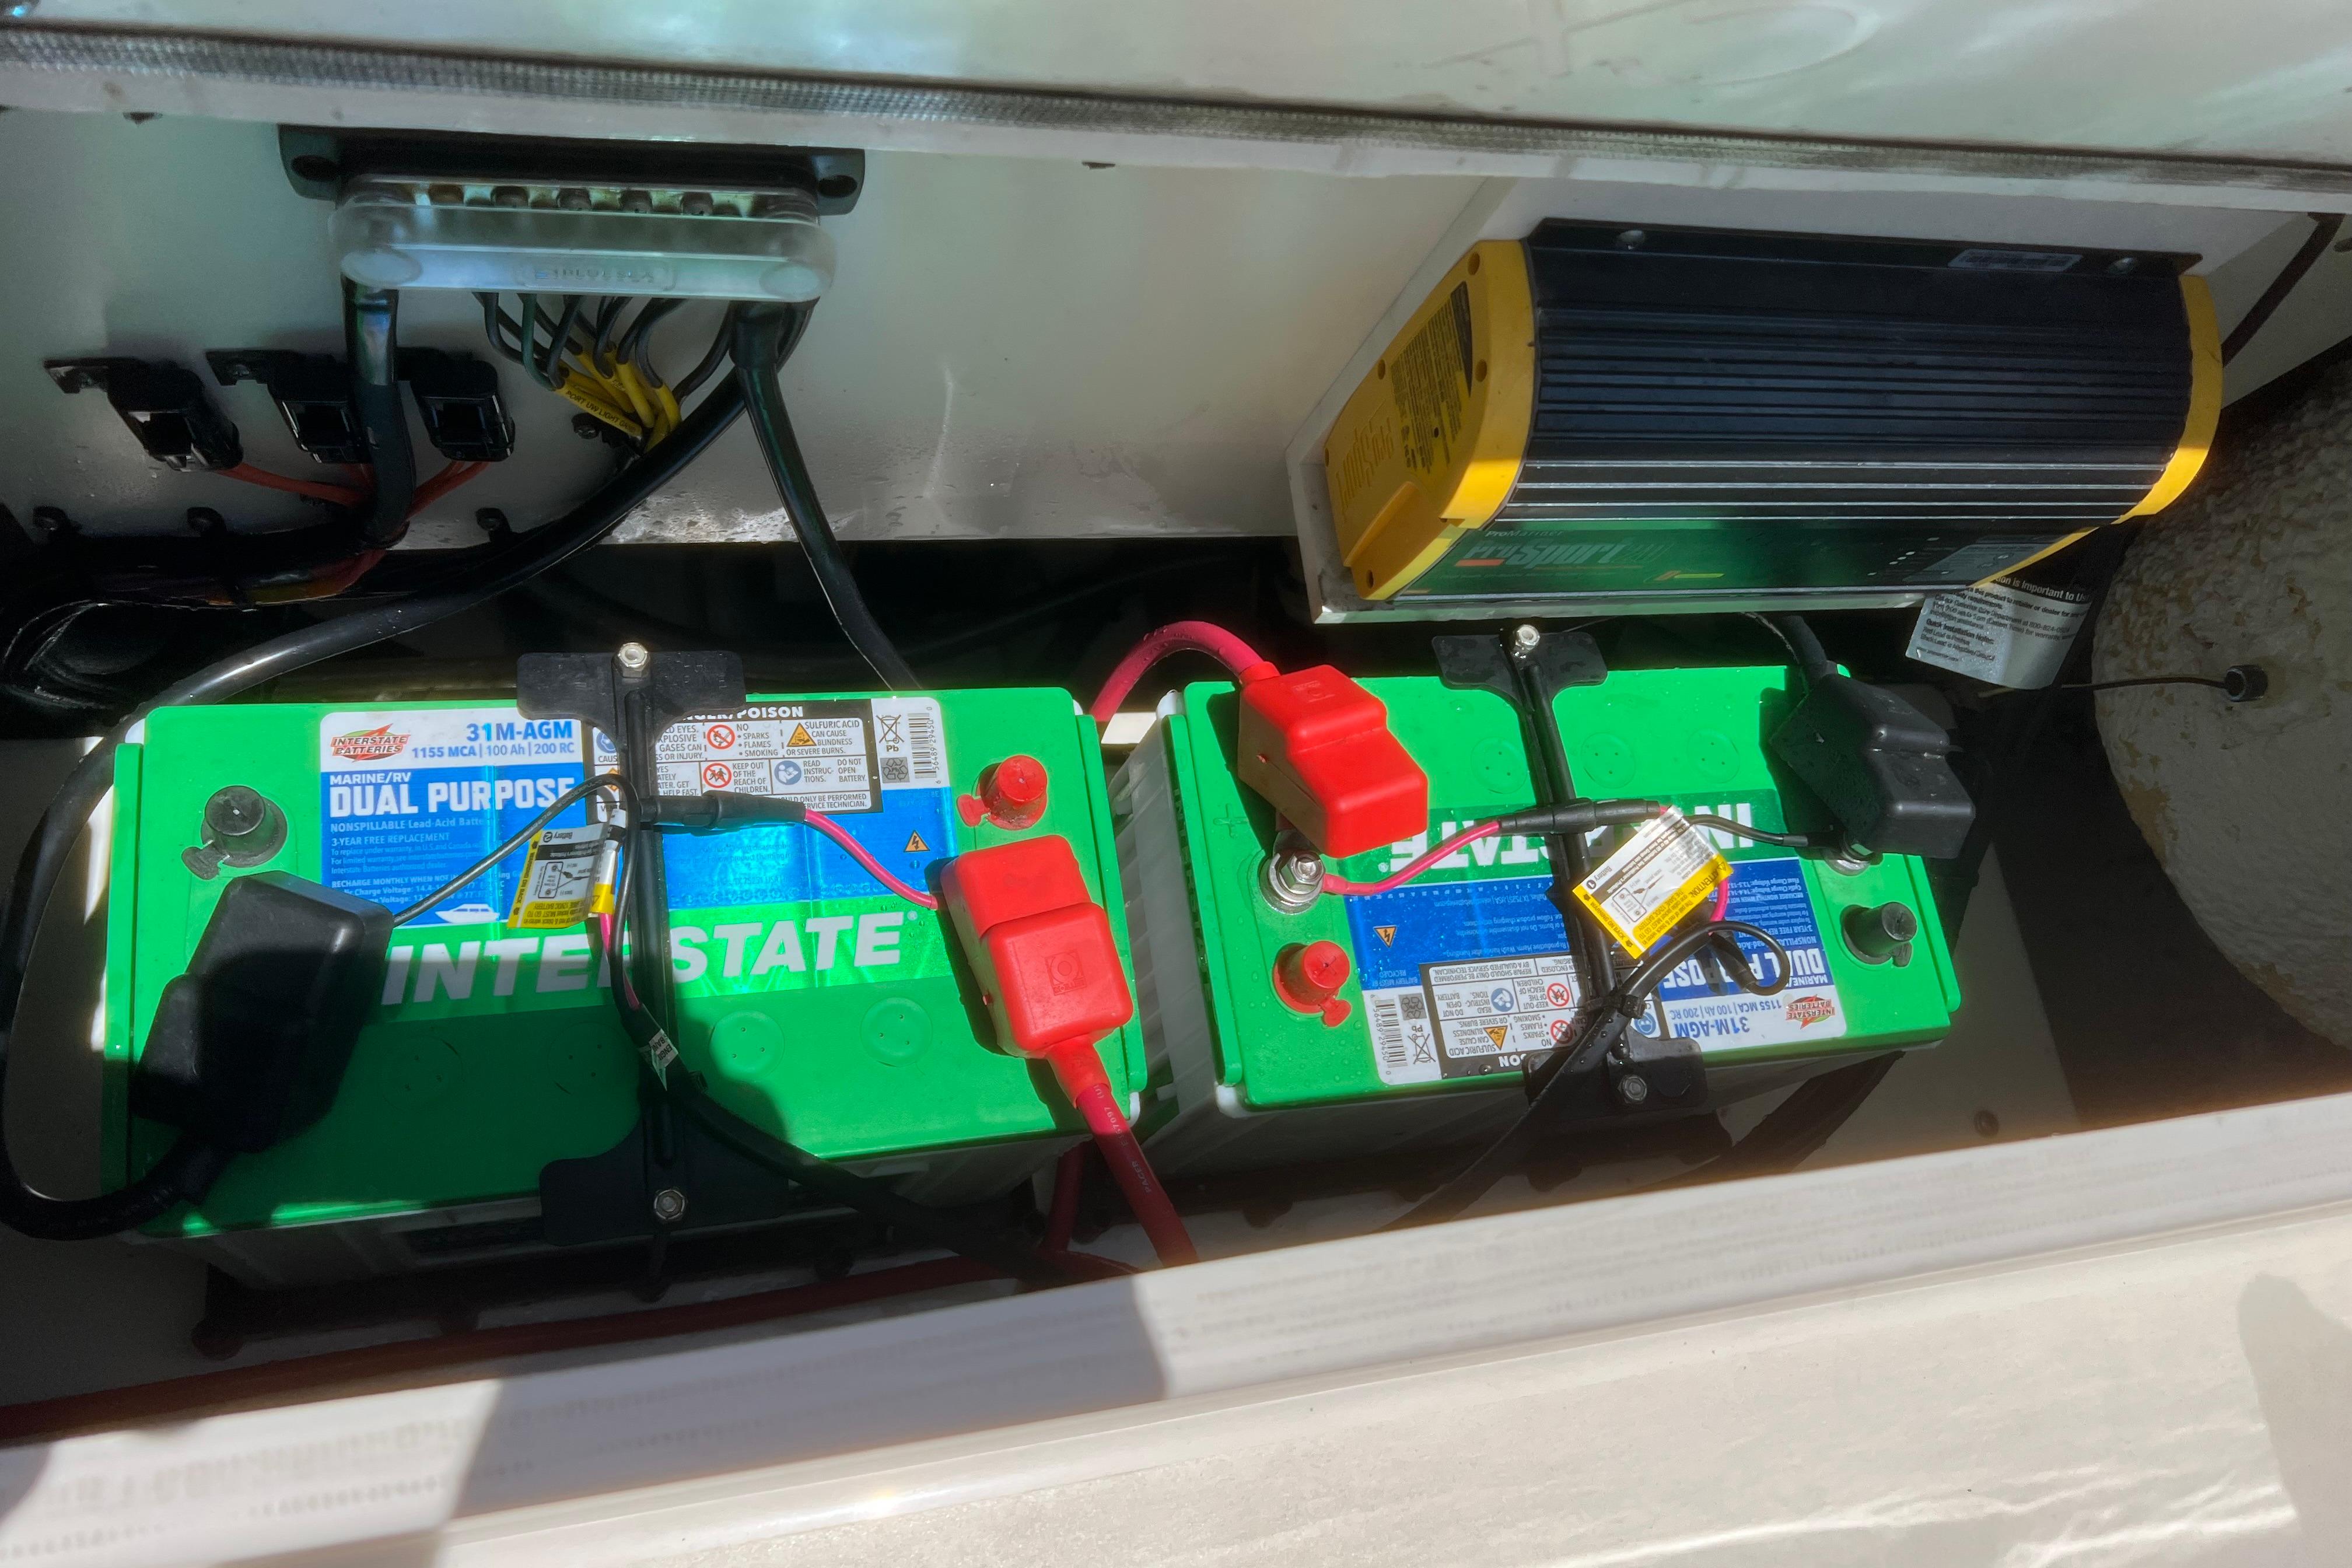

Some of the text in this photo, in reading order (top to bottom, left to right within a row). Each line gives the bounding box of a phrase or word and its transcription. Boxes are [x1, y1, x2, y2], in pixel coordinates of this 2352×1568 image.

[566, 390, 586, 404] PORT
[599, 408, 619, 423] LIGHT
[1485, 529, 1563, 537] ProMariner
[1464, 537, 1628, 569] ProSport
[2013, 579, 2020, 587] is
[2022, 581, 2064, 600] Important
[2065, 592, 2074, 600] to
[1985, 591, 2060, 615] product retailer dealer
[1927, 619, 1942, 627] Quick
[1944, 623, 1974, 638] Installation
[678, 725, 698, 733] EYES.
[805, 721, 841, 729] SULFURIC
[467, 721, 572, 741] 31M-AGM
[927, 720, 936, 743] 29450
[333, 736, 408, 746] INTERSTATE
[659, 734, 697, 743] XPLOSIVE
[335, 746, 402, 755] BATTERIES
[412, 743, 574, 758] 1155 MCA 100 Ah 200 RC
[930, 748, 940, 770] 56489
[330, 772, 411, 785] MARINE/RV
[330, 784, 418, 817] DUAL
[331, 820, 405, 832] NONSPILLABLE
[332, 832, 449, 846] 3-YEAR FREE REPLACEMENT
[1390, 803, 1754, 872] INTATE
[1593, 864, 1612, 882] Battery
[331, 877, 408, 888] RECHARGE MONTHLY
[355, 888, 381, 896] Charge
[1636, 914, 1654, 930] BATTERY
[1650, 918, 1662, 929] MUST
[1644, 926, 1652, 935] GO
[1655, 922, 1667, 934] black
[1793, 925, 1812, 933] 3-YEAR
[1638, 931, 1646, 939] TO
[381, 912, 904, 1005] INTESTATE
[1433, 965, 1466, 975] TECHNICIAN.
[1468, 964, 1488, 972] SERVICE
[1490, 963, 1517, 971] QUALIFIED
[1434, 974, 1467, 982] PERFORMED
[1476, 972, 1489, 980] ONLY
[1490, 970, 1512, 978] SHOULD
[1786, 975, 1828, 986] MARINE/
[1465, 999, 1490, 1007] INSTRUC-
[1789, 1000, 1831, 1010] BATTERIES
[1670, 999, 1782, 1020] 1155 MCA 100 Ah 200 RC
[1787, 1007, 1835, 1019] INTERSTATE
[1513, 1014, 1541, 1022] SMOKING
[1674, 1016, 1750, 1039] 31M-AGM
[1373, 1008, 1383, 1032] 56489
[1378, 1036, 1389, 1060] 29450
[1541, 1038, 1552, 1046] NO
[1449, 1044, 1496, 1056] SULFURIC ACID
